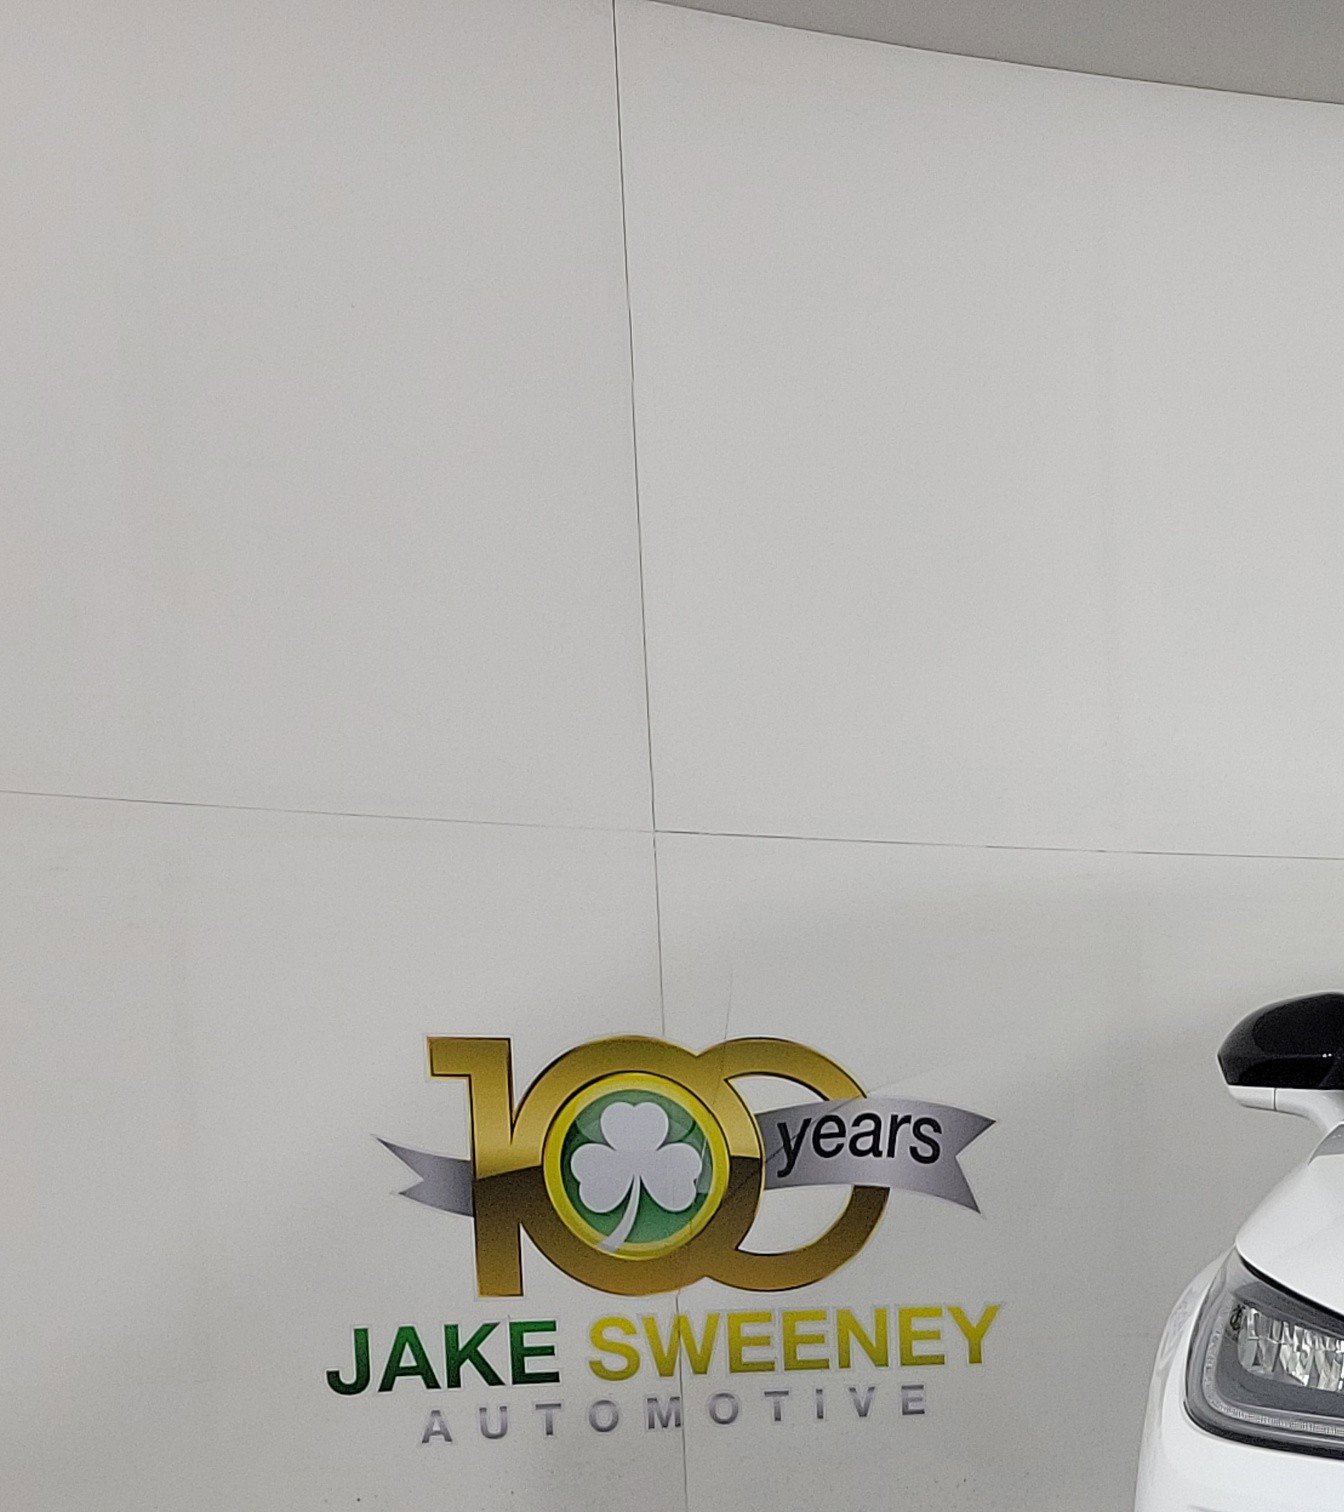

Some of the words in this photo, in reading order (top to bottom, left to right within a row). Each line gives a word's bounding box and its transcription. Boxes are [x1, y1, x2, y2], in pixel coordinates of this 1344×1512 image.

[426, 1035, 890, 1297] 100
[776, 1113, 942, 1177] years
[326, 1319, 559, 1395] JAKE
[588, 1304, 999, 1382] SWEENEY
[421, 1384, 926, 1444] AUTOMOTIVE
